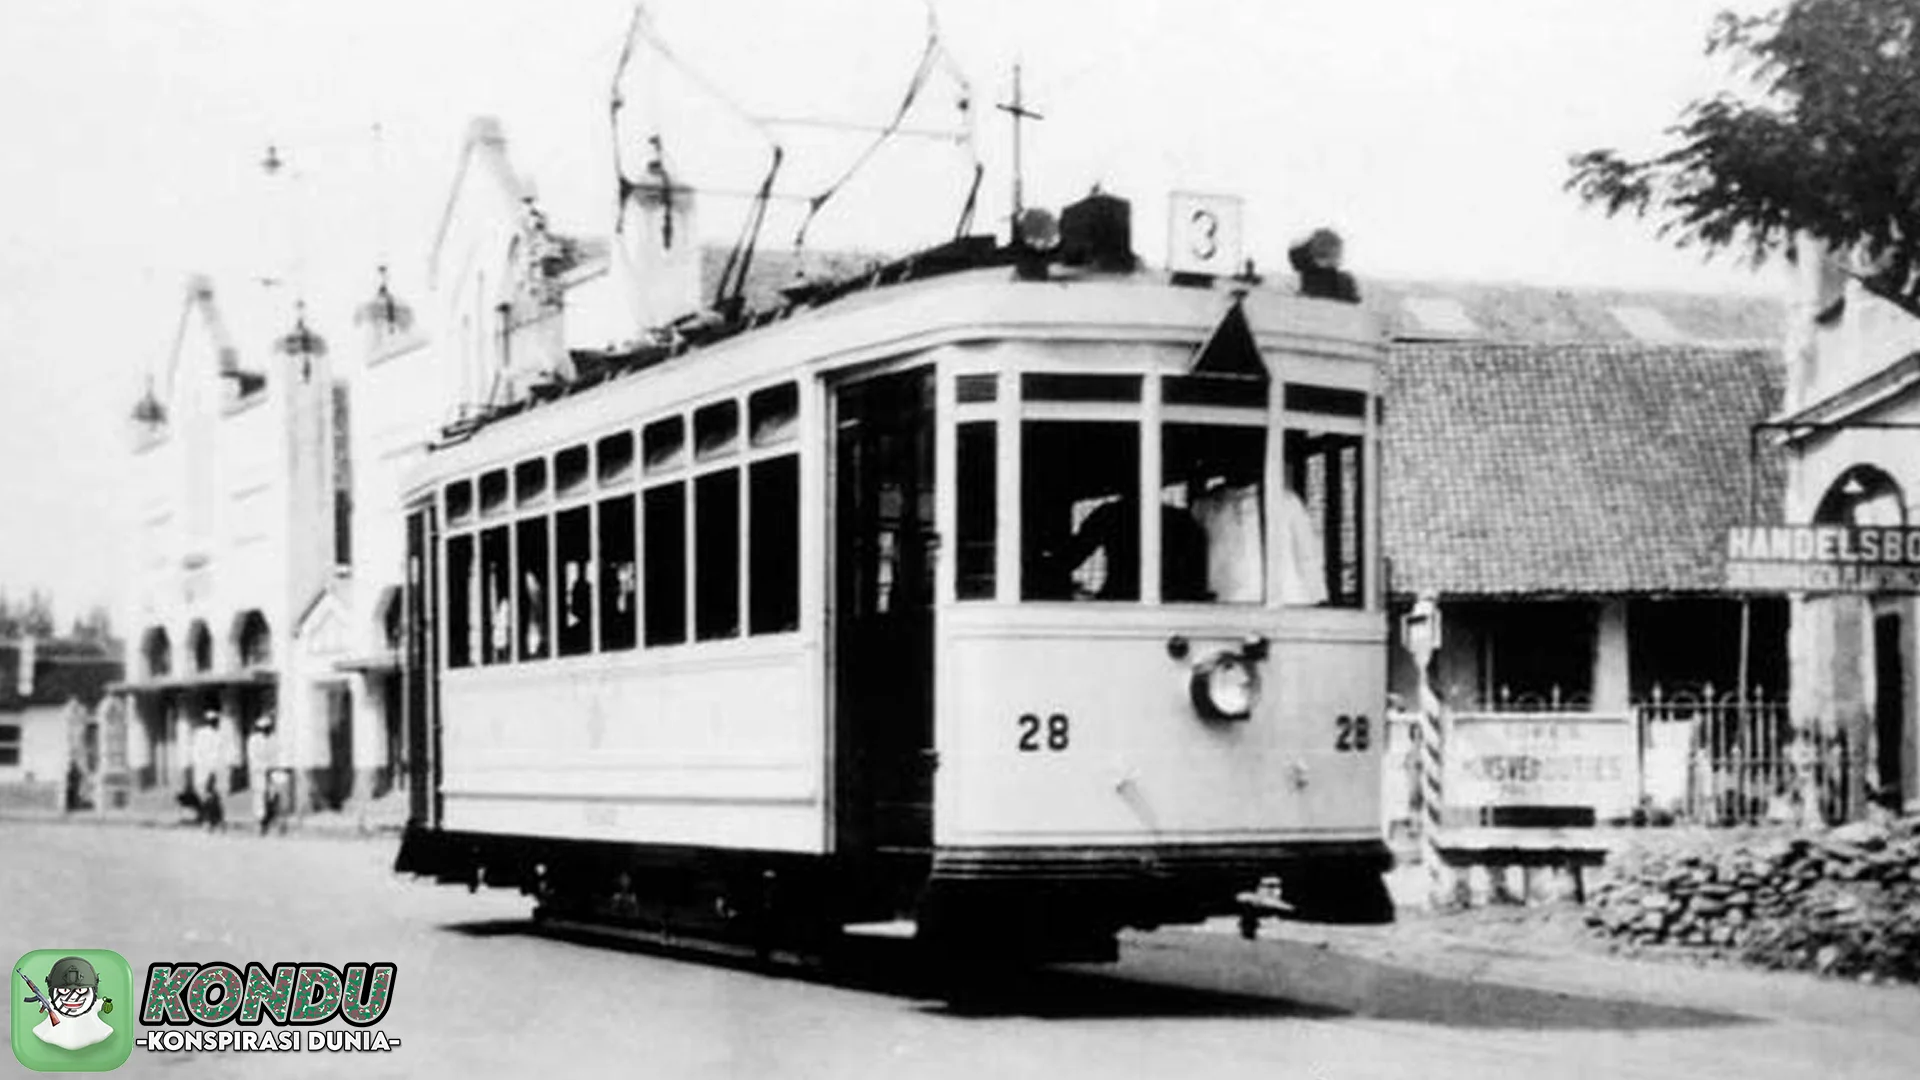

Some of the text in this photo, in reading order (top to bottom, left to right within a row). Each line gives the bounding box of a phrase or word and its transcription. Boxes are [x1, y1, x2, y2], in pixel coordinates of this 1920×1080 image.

[1190, 208, 1219, 261] 3
[1018, 713, 1069, 751] 28
[1334, 714, 1370, 751] 28
